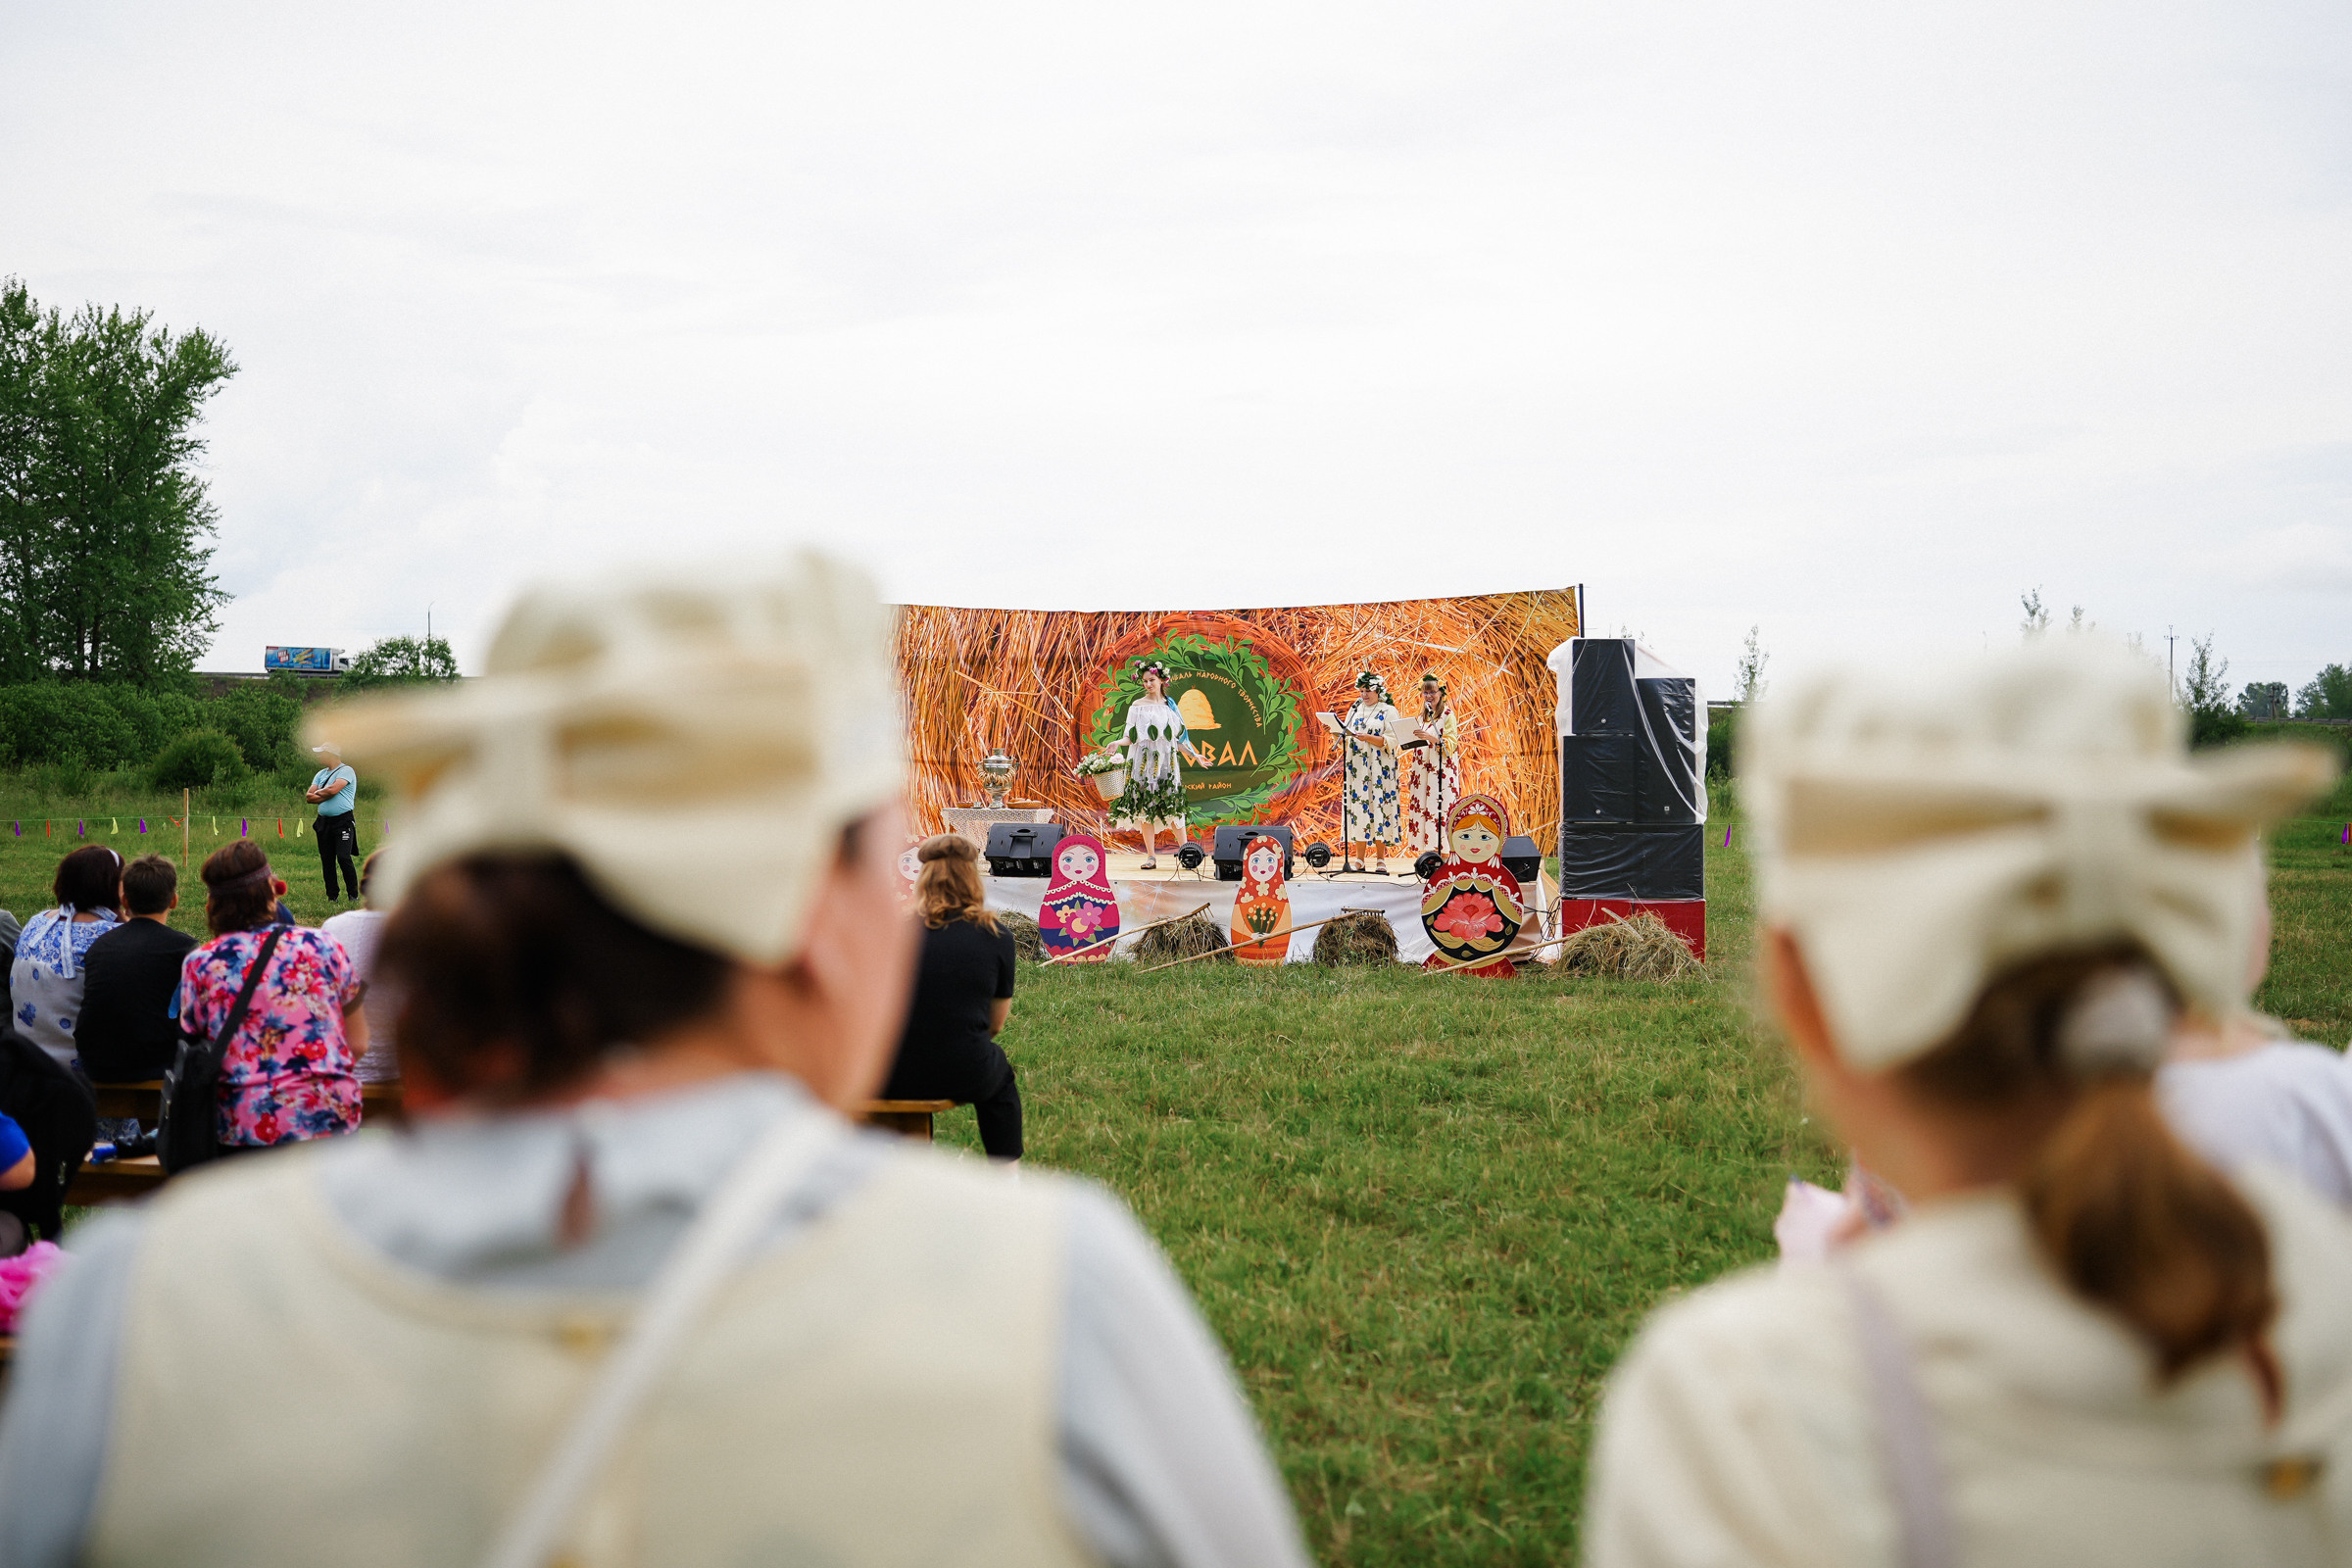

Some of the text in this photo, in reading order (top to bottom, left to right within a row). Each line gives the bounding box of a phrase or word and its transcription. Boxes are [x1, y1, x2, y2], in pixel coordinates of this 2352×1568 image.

[1169, 670, 1262, 728] ИВАЛЬ НАРОДНОГО ТВОРЧЕСТВА
[1178, 740, 1258, 767] ОВАЛ
[1208, 781, 1232, 790] РАЙОН
